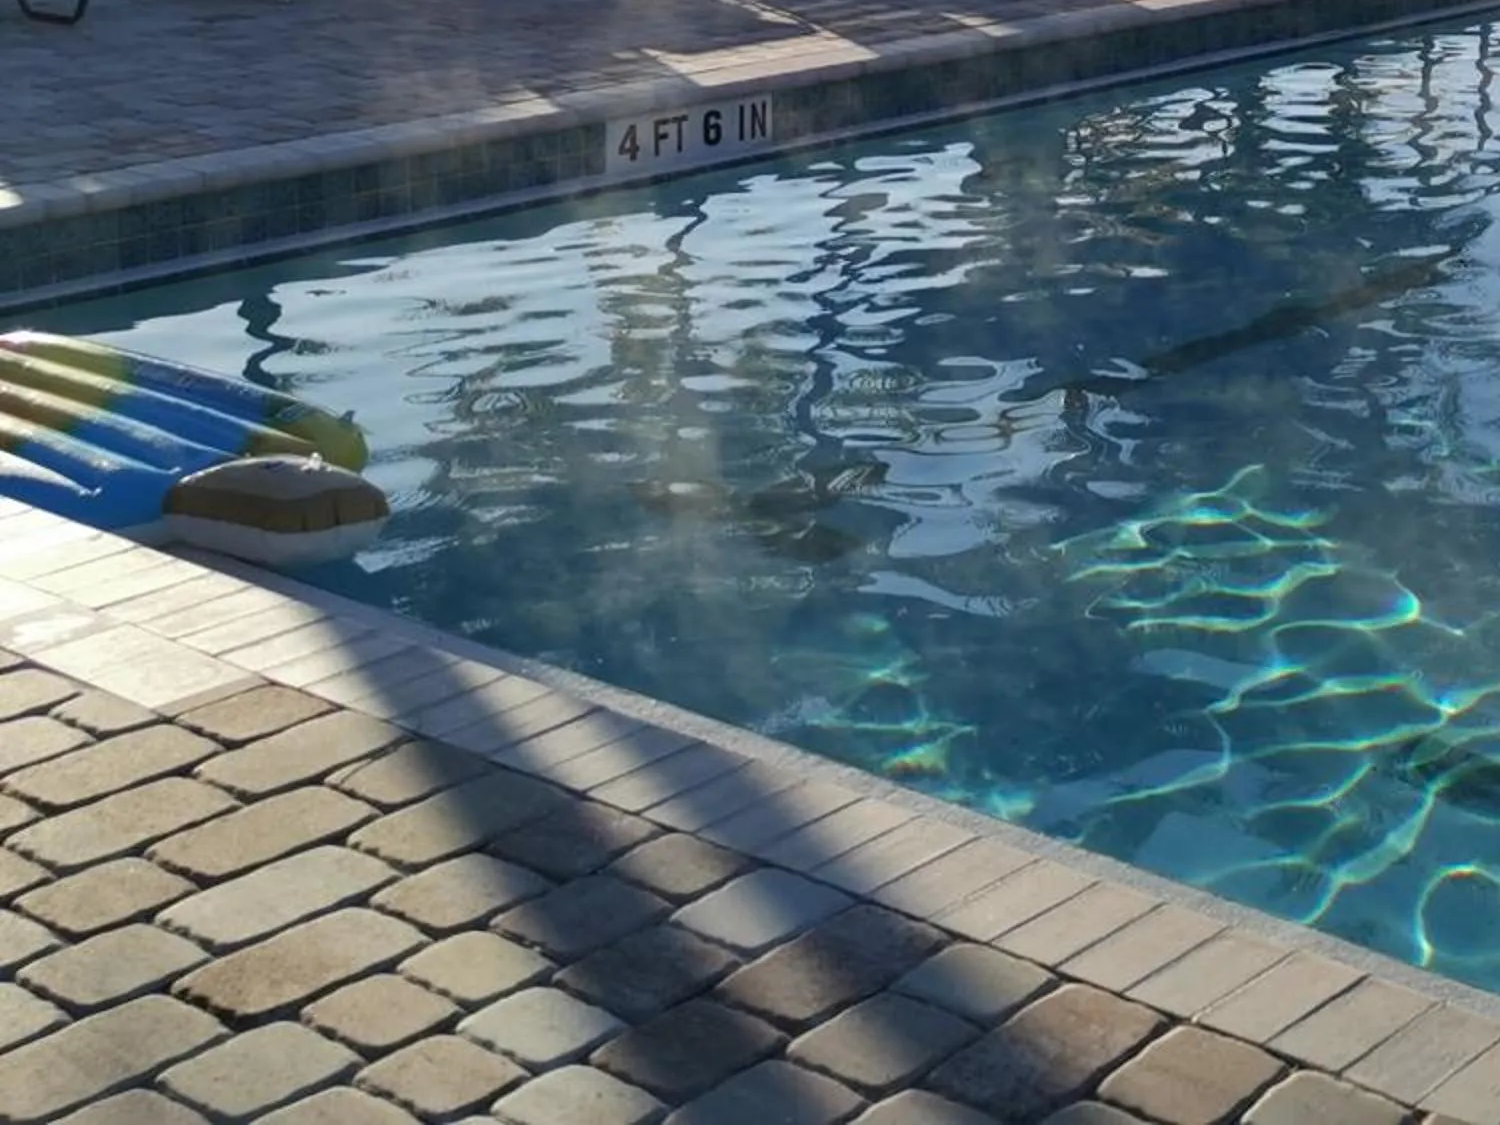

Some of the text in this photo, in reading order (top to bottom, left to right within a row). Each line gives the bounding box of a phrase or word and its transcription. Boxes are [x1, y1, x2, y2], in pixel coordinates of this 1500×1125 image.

[618, 100, 767, 162] 4 FT 6 IN
